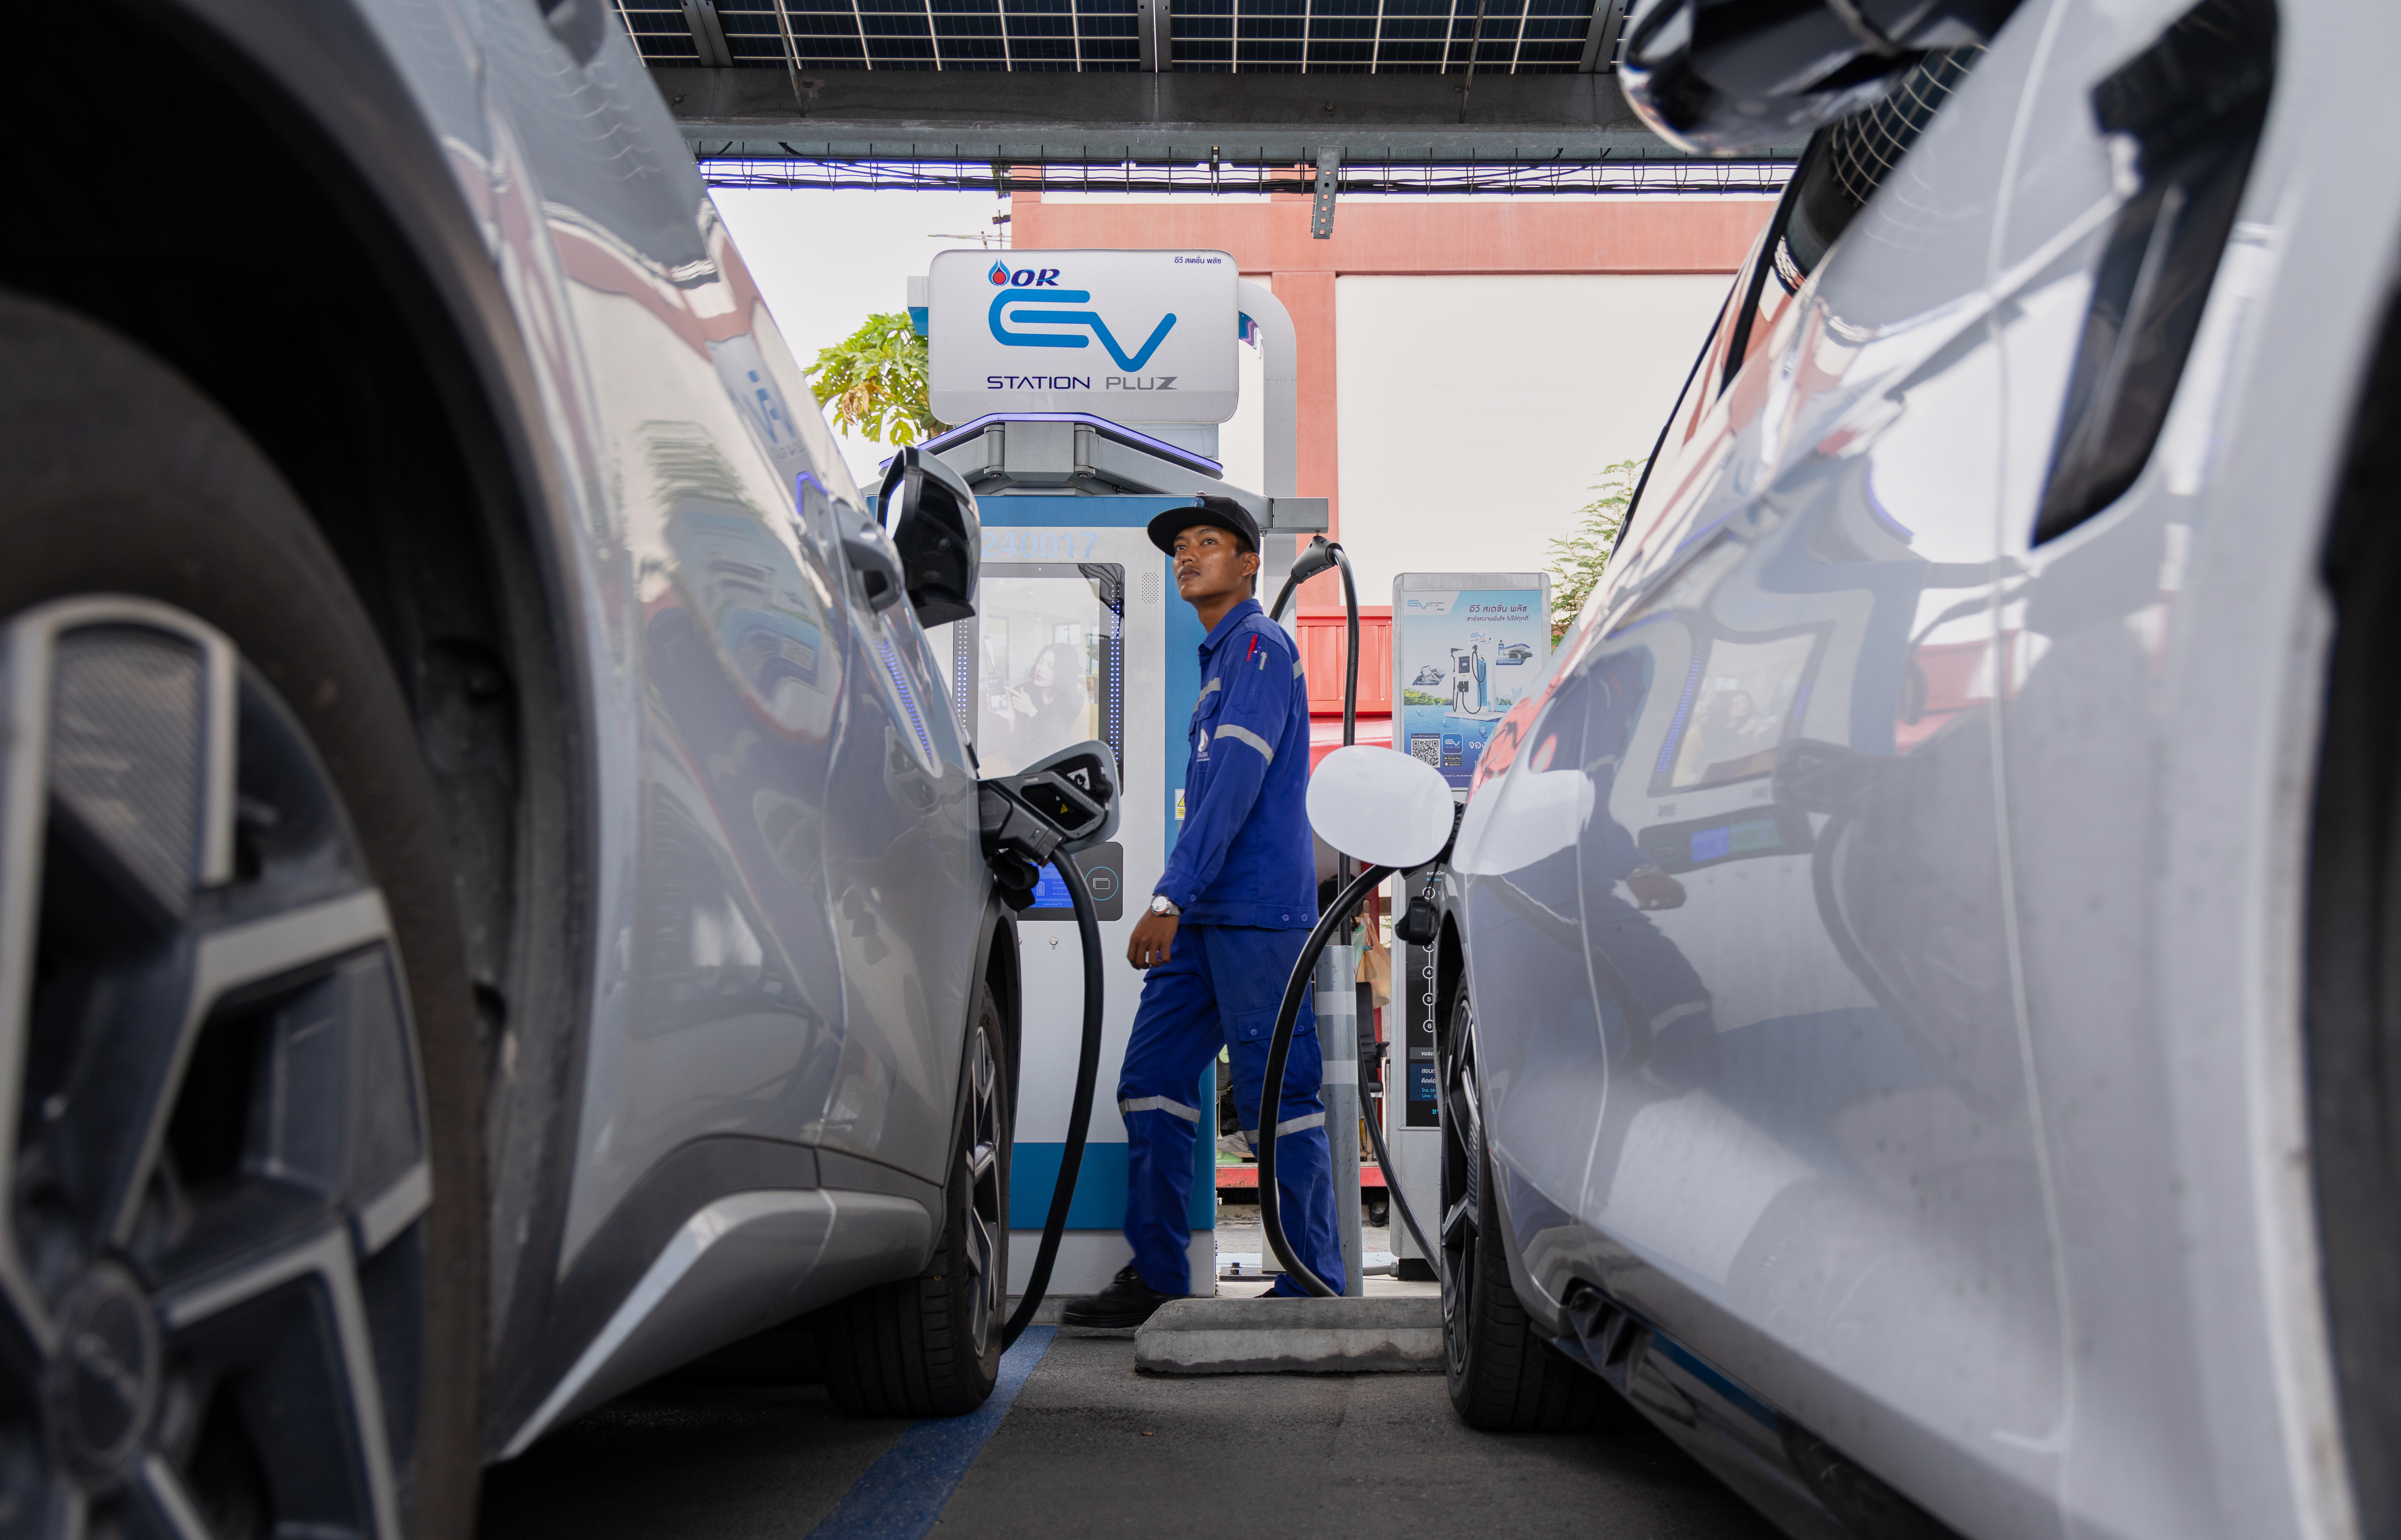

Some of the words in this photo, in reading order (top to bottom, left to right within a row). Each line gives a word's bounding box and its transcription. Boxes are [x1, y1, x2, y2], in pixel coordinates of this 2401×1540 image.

[1185, 255, 1205, 264] สเตชั่น
[1010, 268, 1060, 287] OR
[988, 289, 1176, 372] EV
[987, 376, 1090, 389] STATION
[1106, 376, 1178, 390] PLUZ
[980, 531, 1100, 559] 240017
[1407, 599, 1429, 610] EV
[1469, 604, 1480, 613] อีวี
[1483, 602, 1507, 613] สเตชั่น
[1510, 603, 1528, 612] พลัซ
